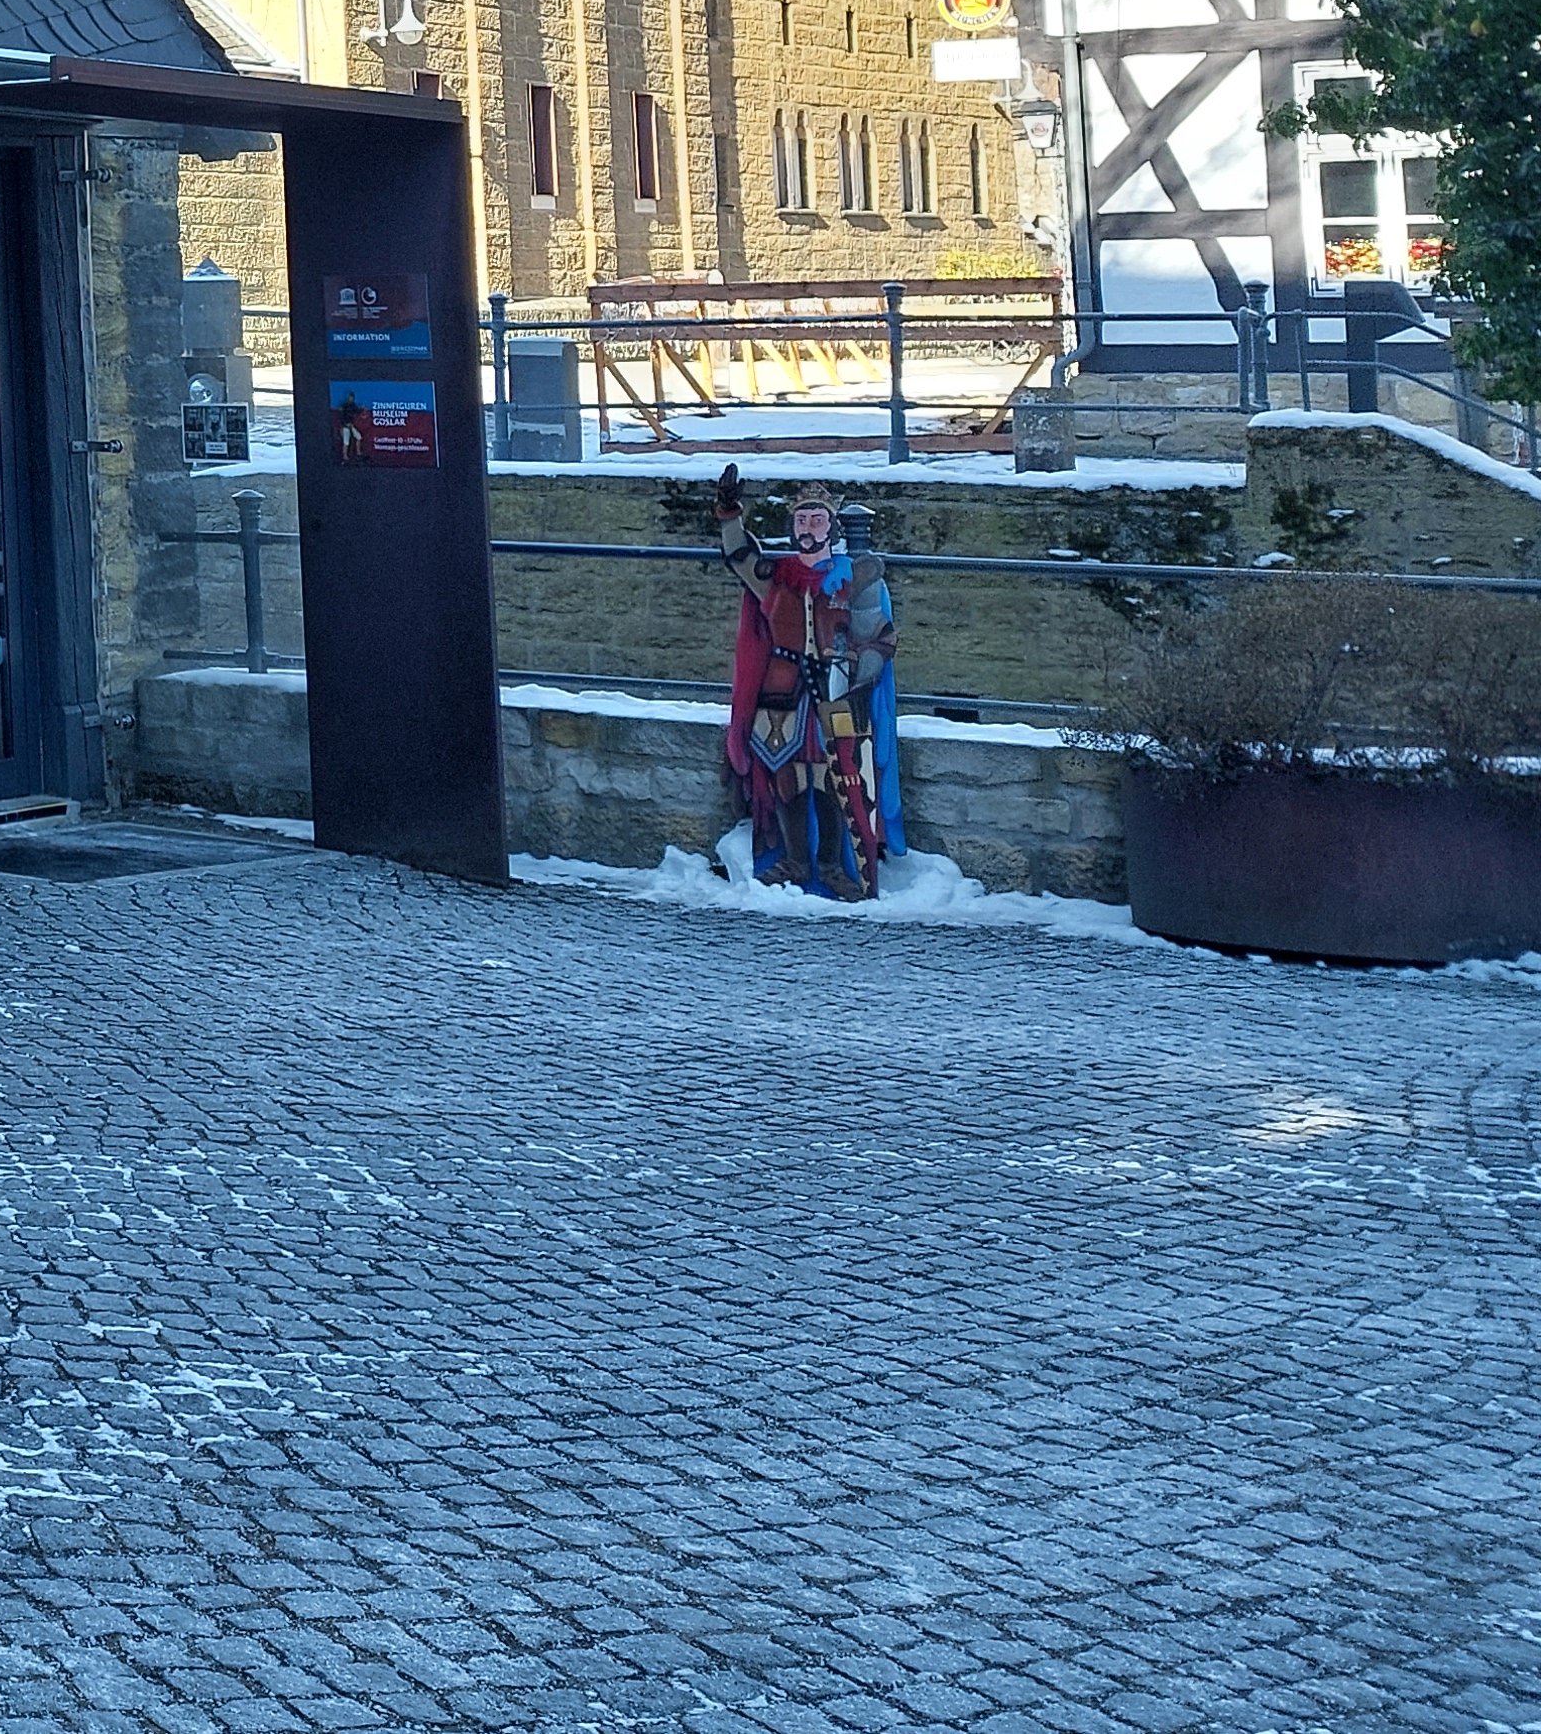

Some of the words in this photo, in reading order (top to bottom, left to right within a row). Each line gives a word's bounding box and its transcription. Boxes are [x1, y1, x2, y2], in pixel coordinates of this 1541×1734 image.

[333, 333, 391, 342] INFORMATION
[372, 401, 427, 411] ZINNFIGUREN
[372, 410, 408, 418] MUSEUM
[373, 418, 406, 427] GOSLAR
